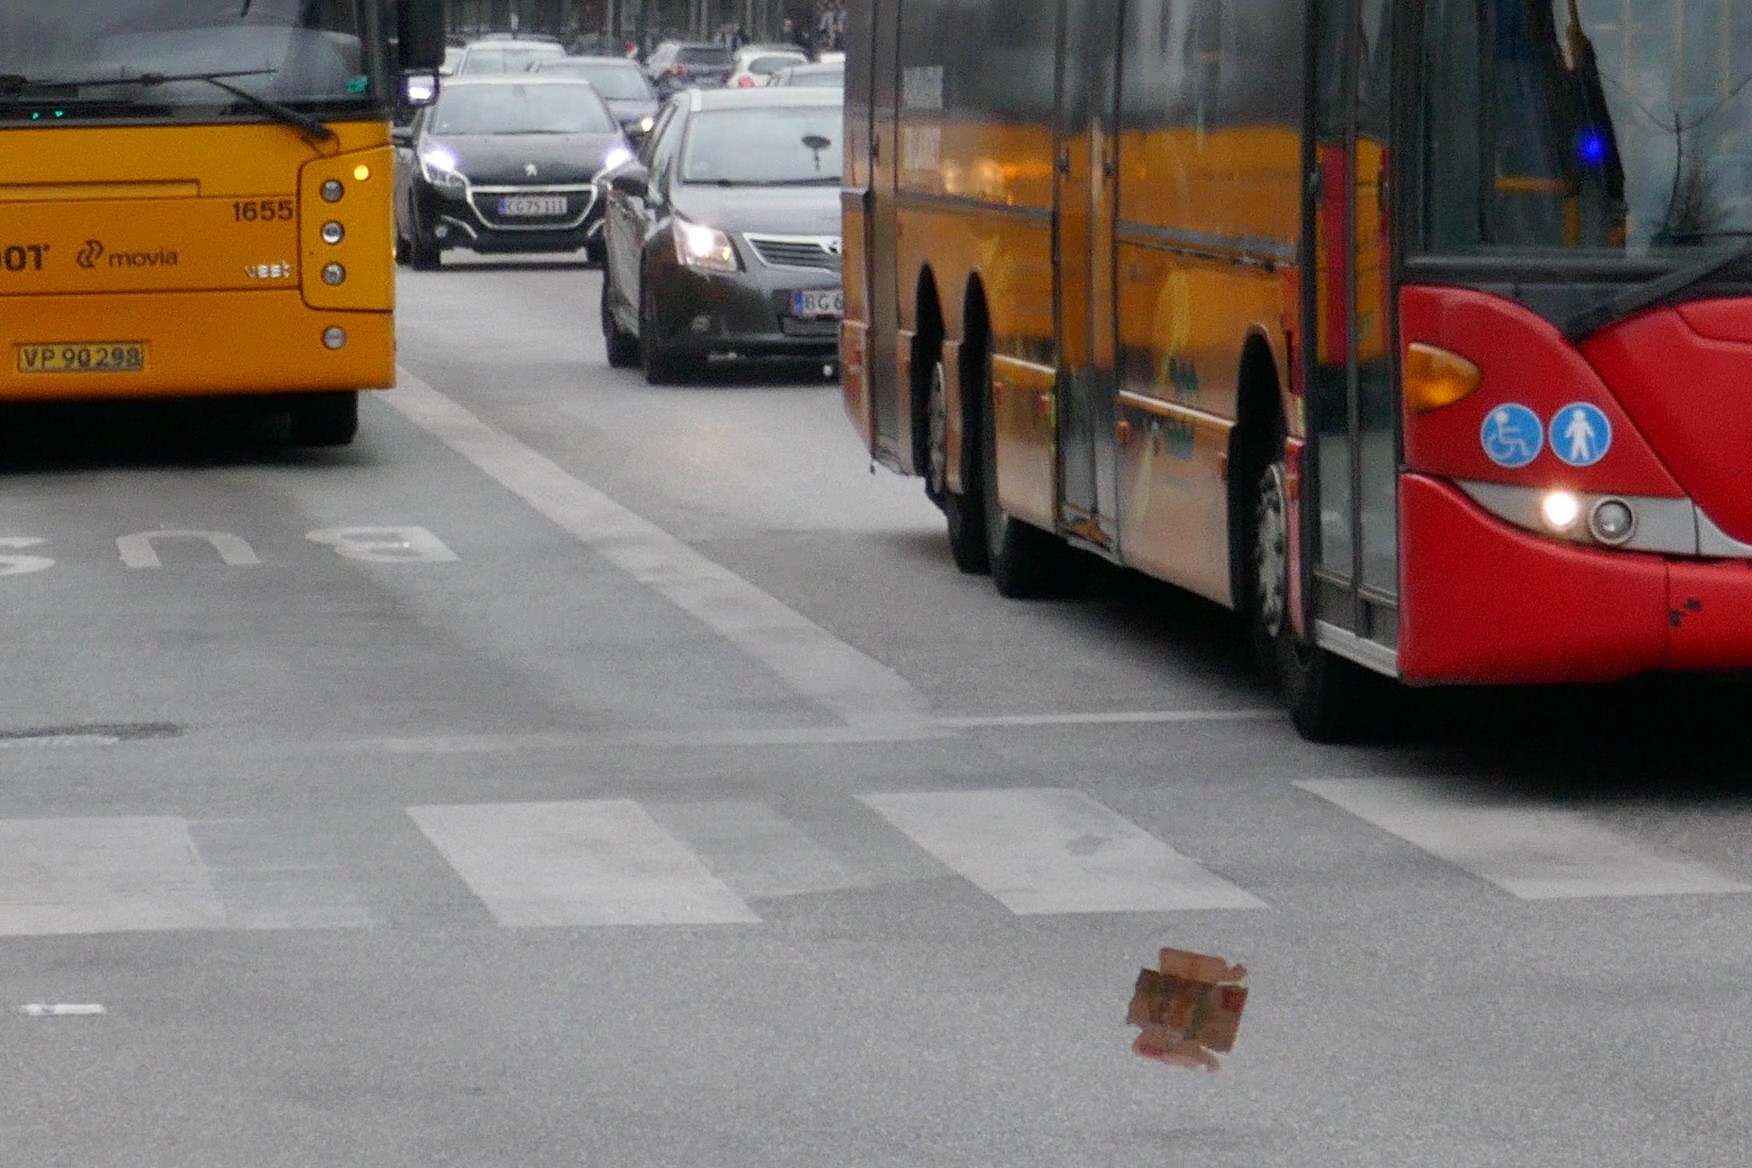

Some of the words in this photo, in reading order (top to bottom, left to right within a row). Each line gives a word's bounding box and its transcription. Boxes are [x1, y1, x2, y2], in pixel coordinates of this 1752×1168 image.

[232, 200, 293, 222] 1655
[0, 244, 49, 271] OT
[108, 247, 178, 268] movia
[23, 348, 55, 368] VP
